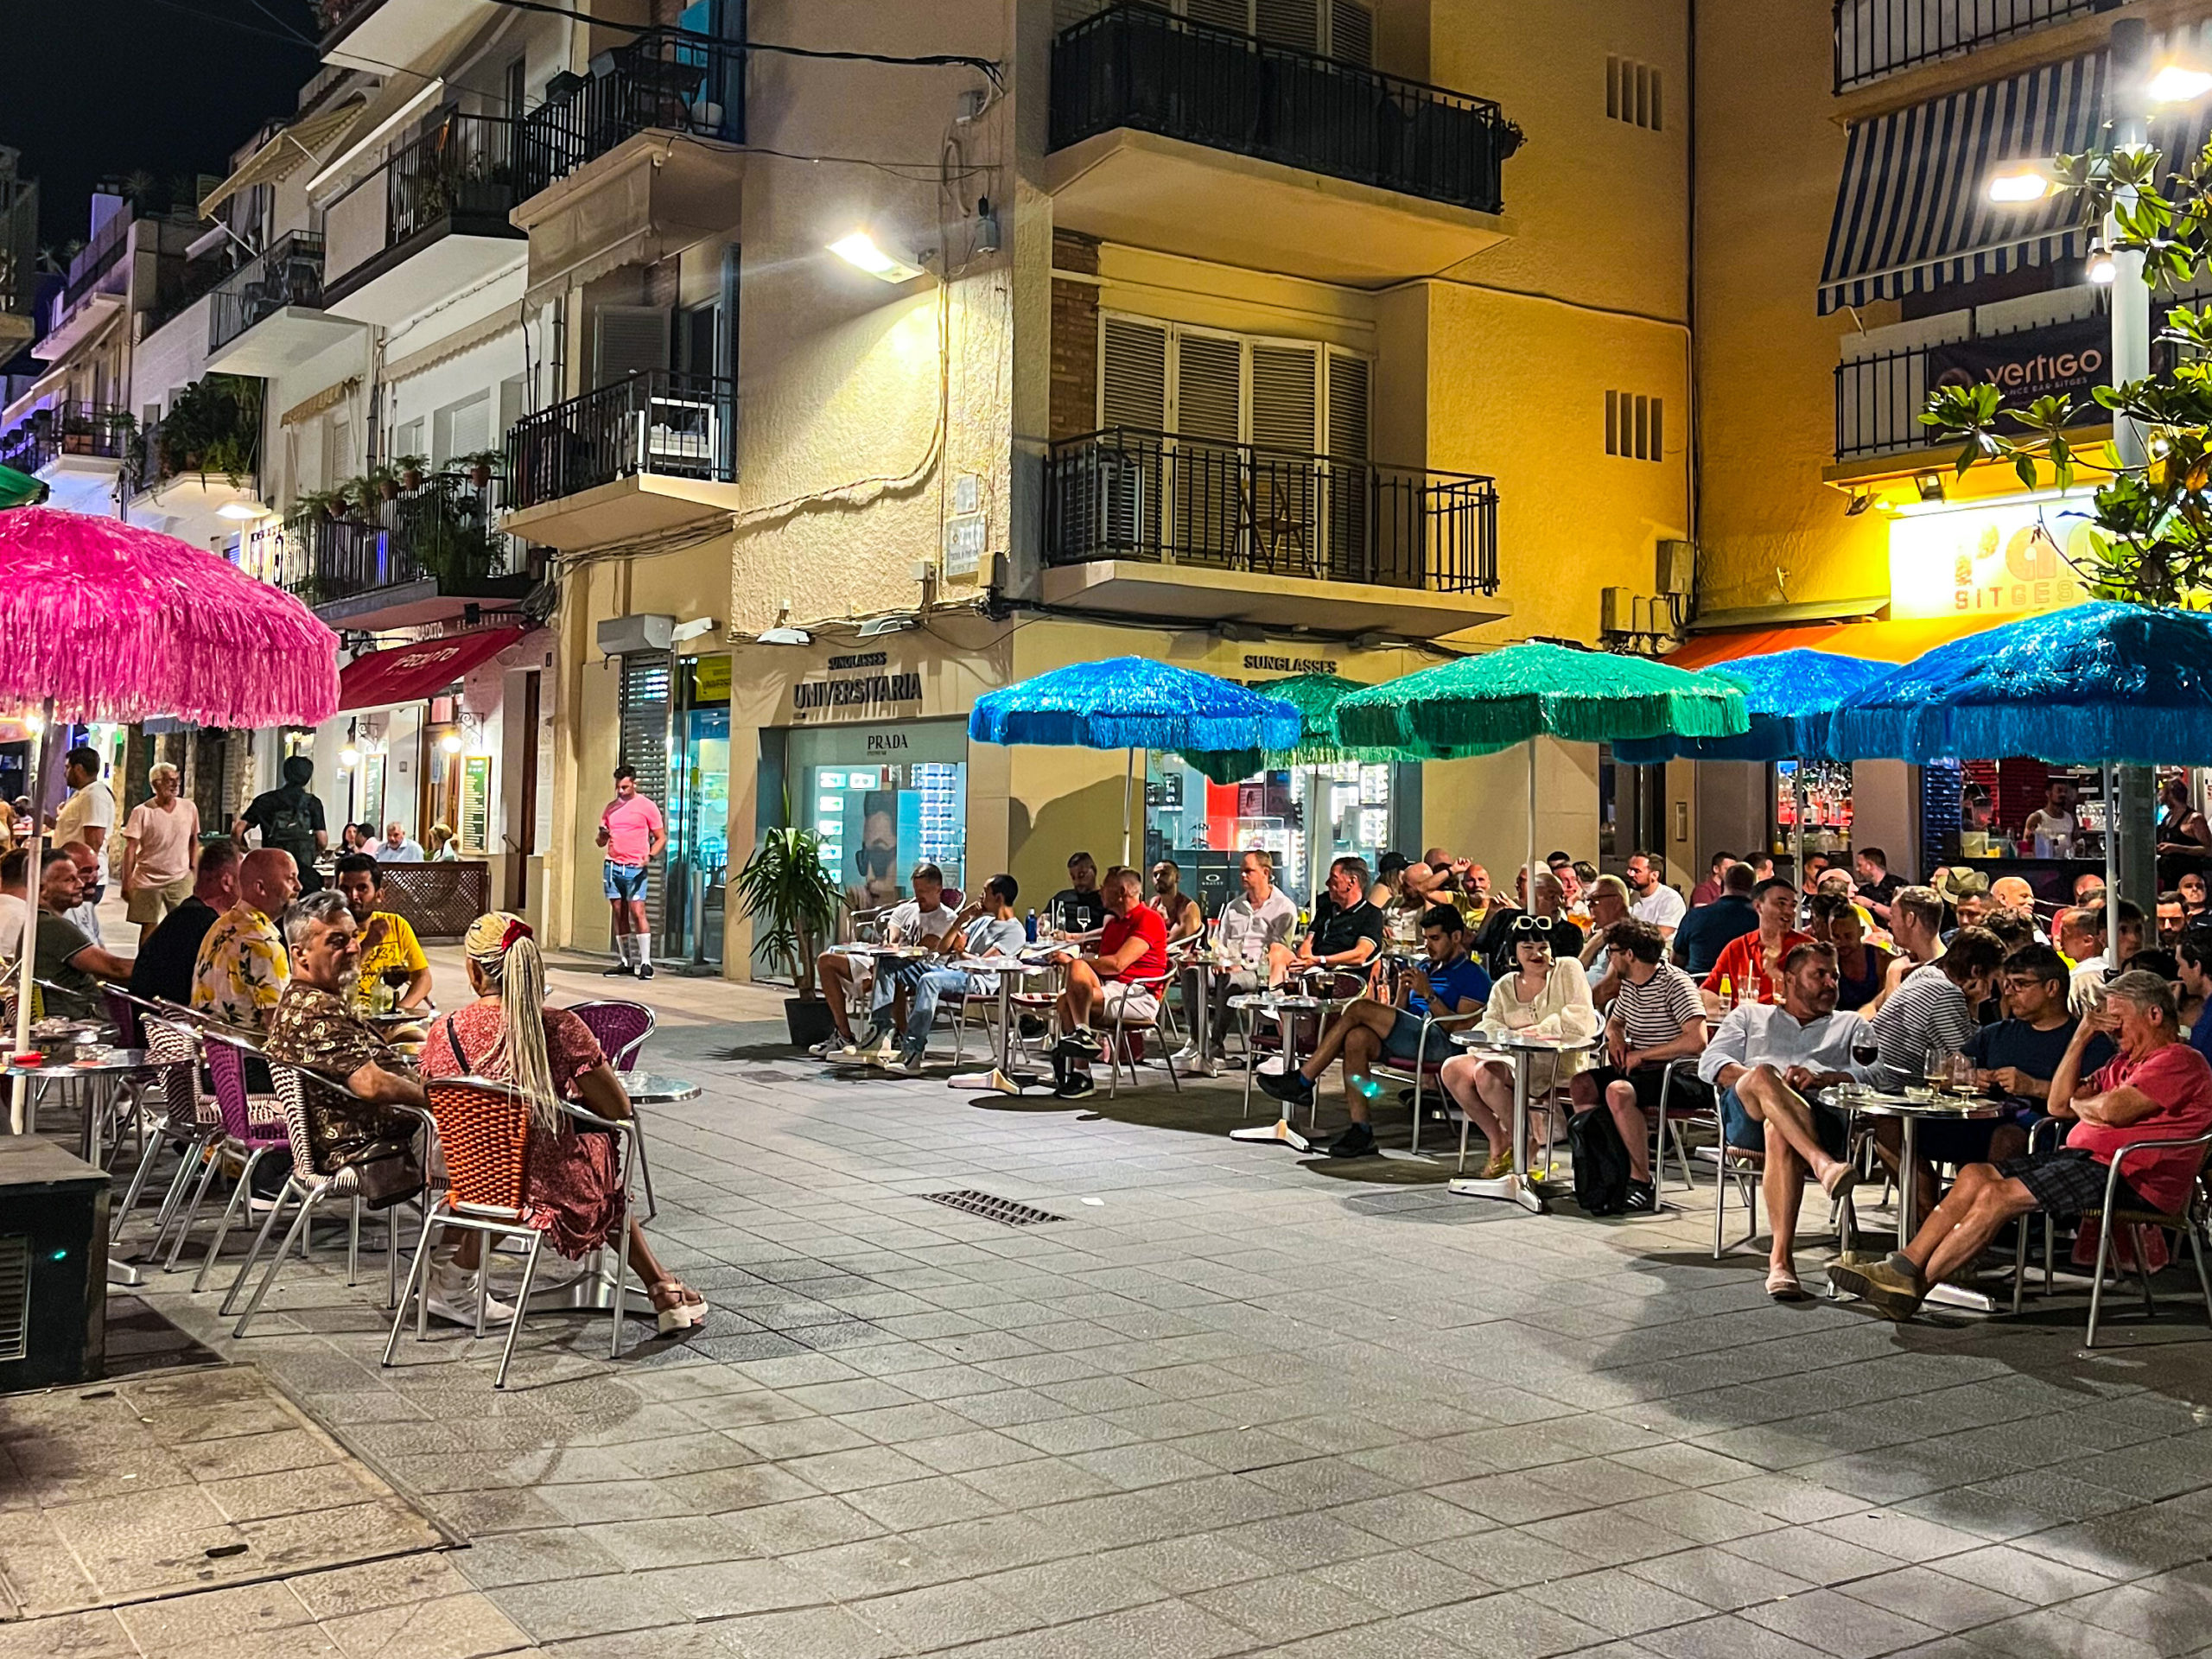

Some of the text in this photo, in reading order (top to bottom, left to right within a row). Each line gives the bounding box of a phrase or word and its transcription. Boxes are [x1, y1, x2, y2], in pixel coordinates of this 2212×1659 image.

[1955, 580, 2075, 610] SITGES
[828, 652, 887, 671] SUNGLASSES
[1243, 655, 1338, 674] SUNGLASSES
[793, 673, 923, 709] UNIVERSITARIA
[868, 734, 908, 750] PRADA
